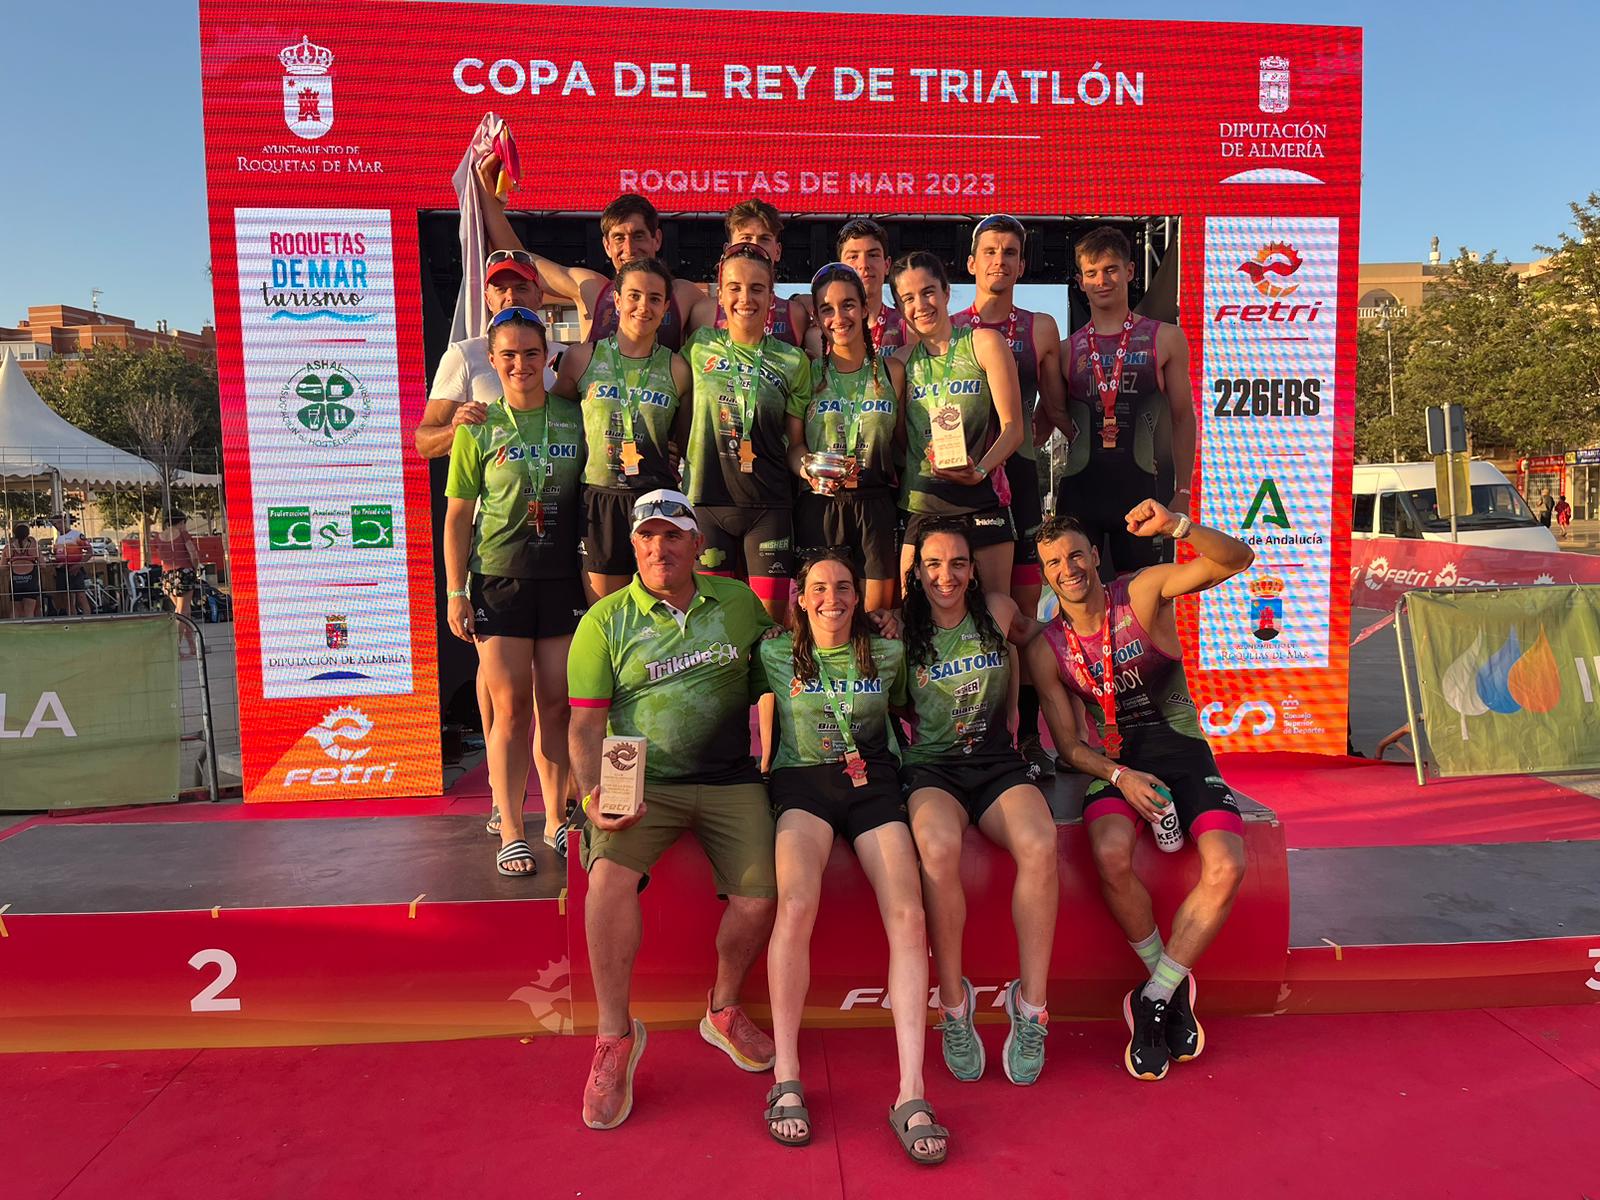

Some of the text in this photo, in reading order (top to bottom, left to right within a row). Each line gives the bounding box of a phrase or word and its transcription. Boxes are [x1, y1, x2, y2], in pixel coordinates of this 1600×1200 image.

[452, 57, 1145, 107] COPA DEL REY DE TRIATLÓN
[1218, 121, 1328, 140] DIPUTACIÓN
[340, 146, 361, 156] DE
[1220, 139, 1326, 159] DE ALMERÍA
[619, 168, 996, 196] ROQUETAS DE MAR 2023
[269, 231, 366, 256] ROQUETAS
[271, 258, 368, 289] DE MAR
[259, 281, 364, 307] turismo
[305, 359, 344, 374] ASHAL
[912, 379, 982, 401] SLOKI
[1086, 368, 1139, 397] JIÉEZ
[595, 384, 672, 409] SATOKI
[817, 399, 894, 416] SAOKI
[1213, 378, 1321, 417] 226ERS
[508, 444, 577, 461] SLOKI
[1248, 534, 1263, 546] de
[1265, 532, 1323, 545] Andalucía
[268, 652, 407, 668] DIPUTACIÓN DE ALMERÍA
[930, 650, 1004, 681] SALTOKI
[1087, 638, 1145, 679] AOKI
[187, 948, 241, 1012] 2
